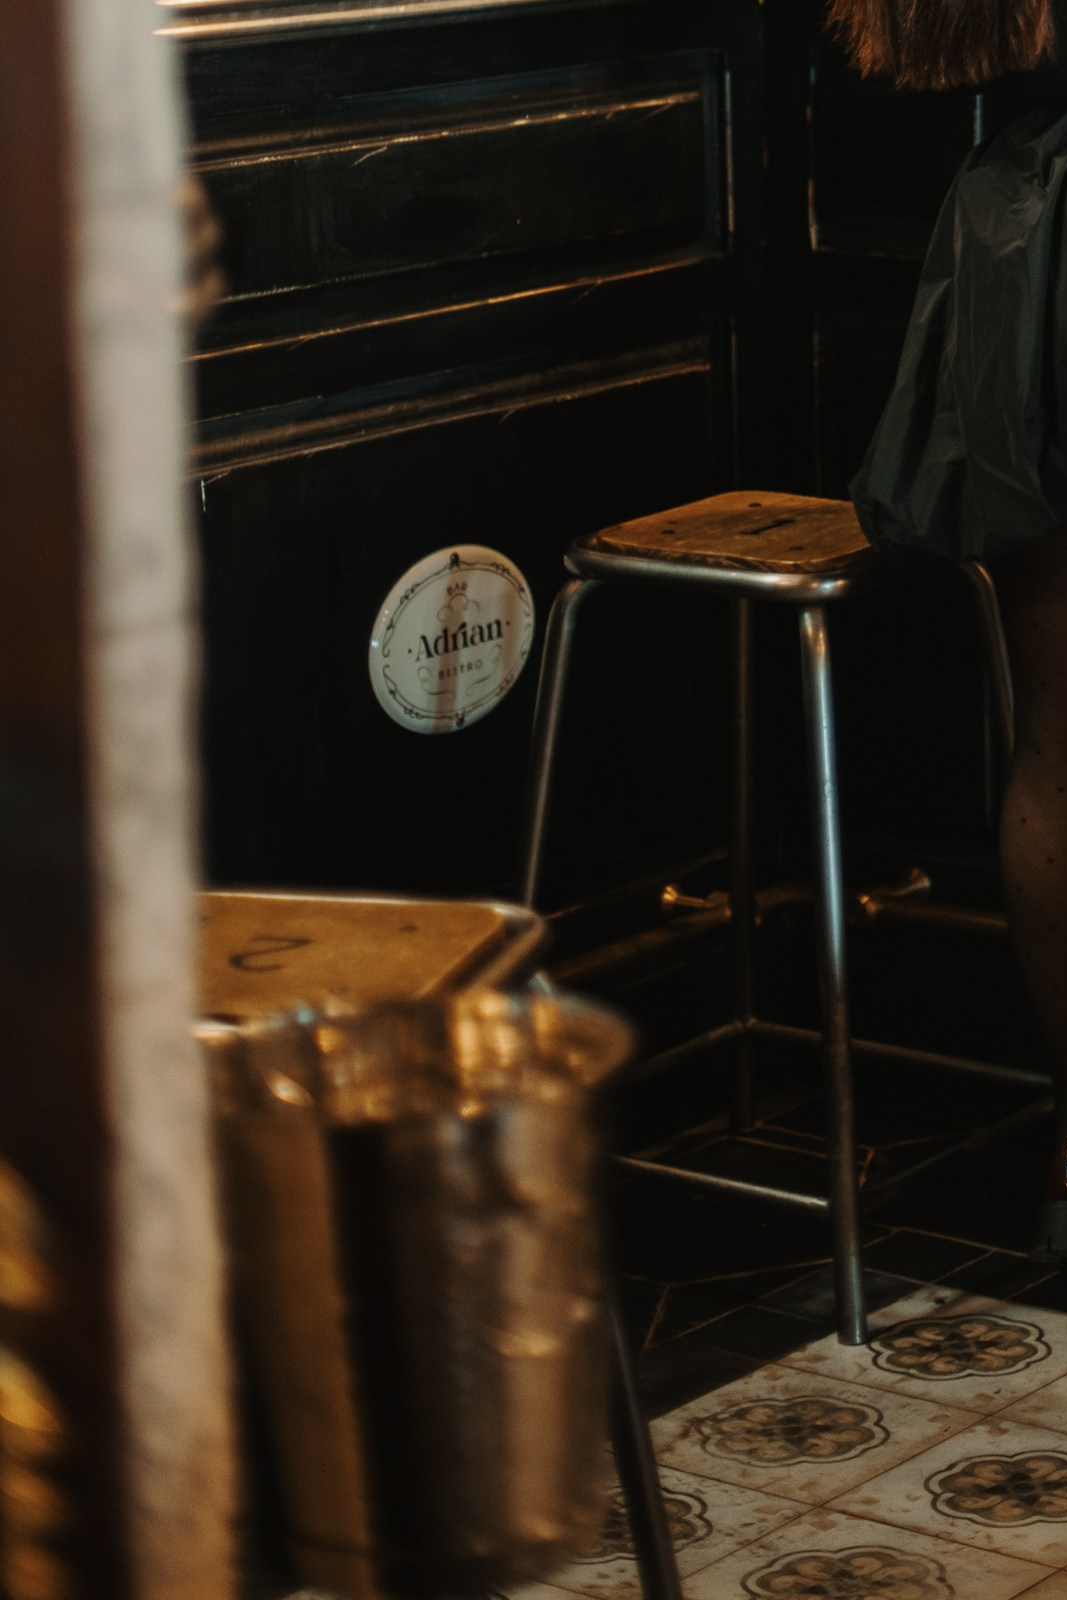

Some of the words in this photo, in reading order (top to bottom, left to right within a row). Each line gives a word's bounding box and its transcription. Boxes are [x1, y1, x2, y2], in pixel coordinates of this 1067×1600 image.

[446, 582, 469, 595] BAR
[414, 618, 504, 662] Adrian
[438, 659, 484, 680] BISTRO
